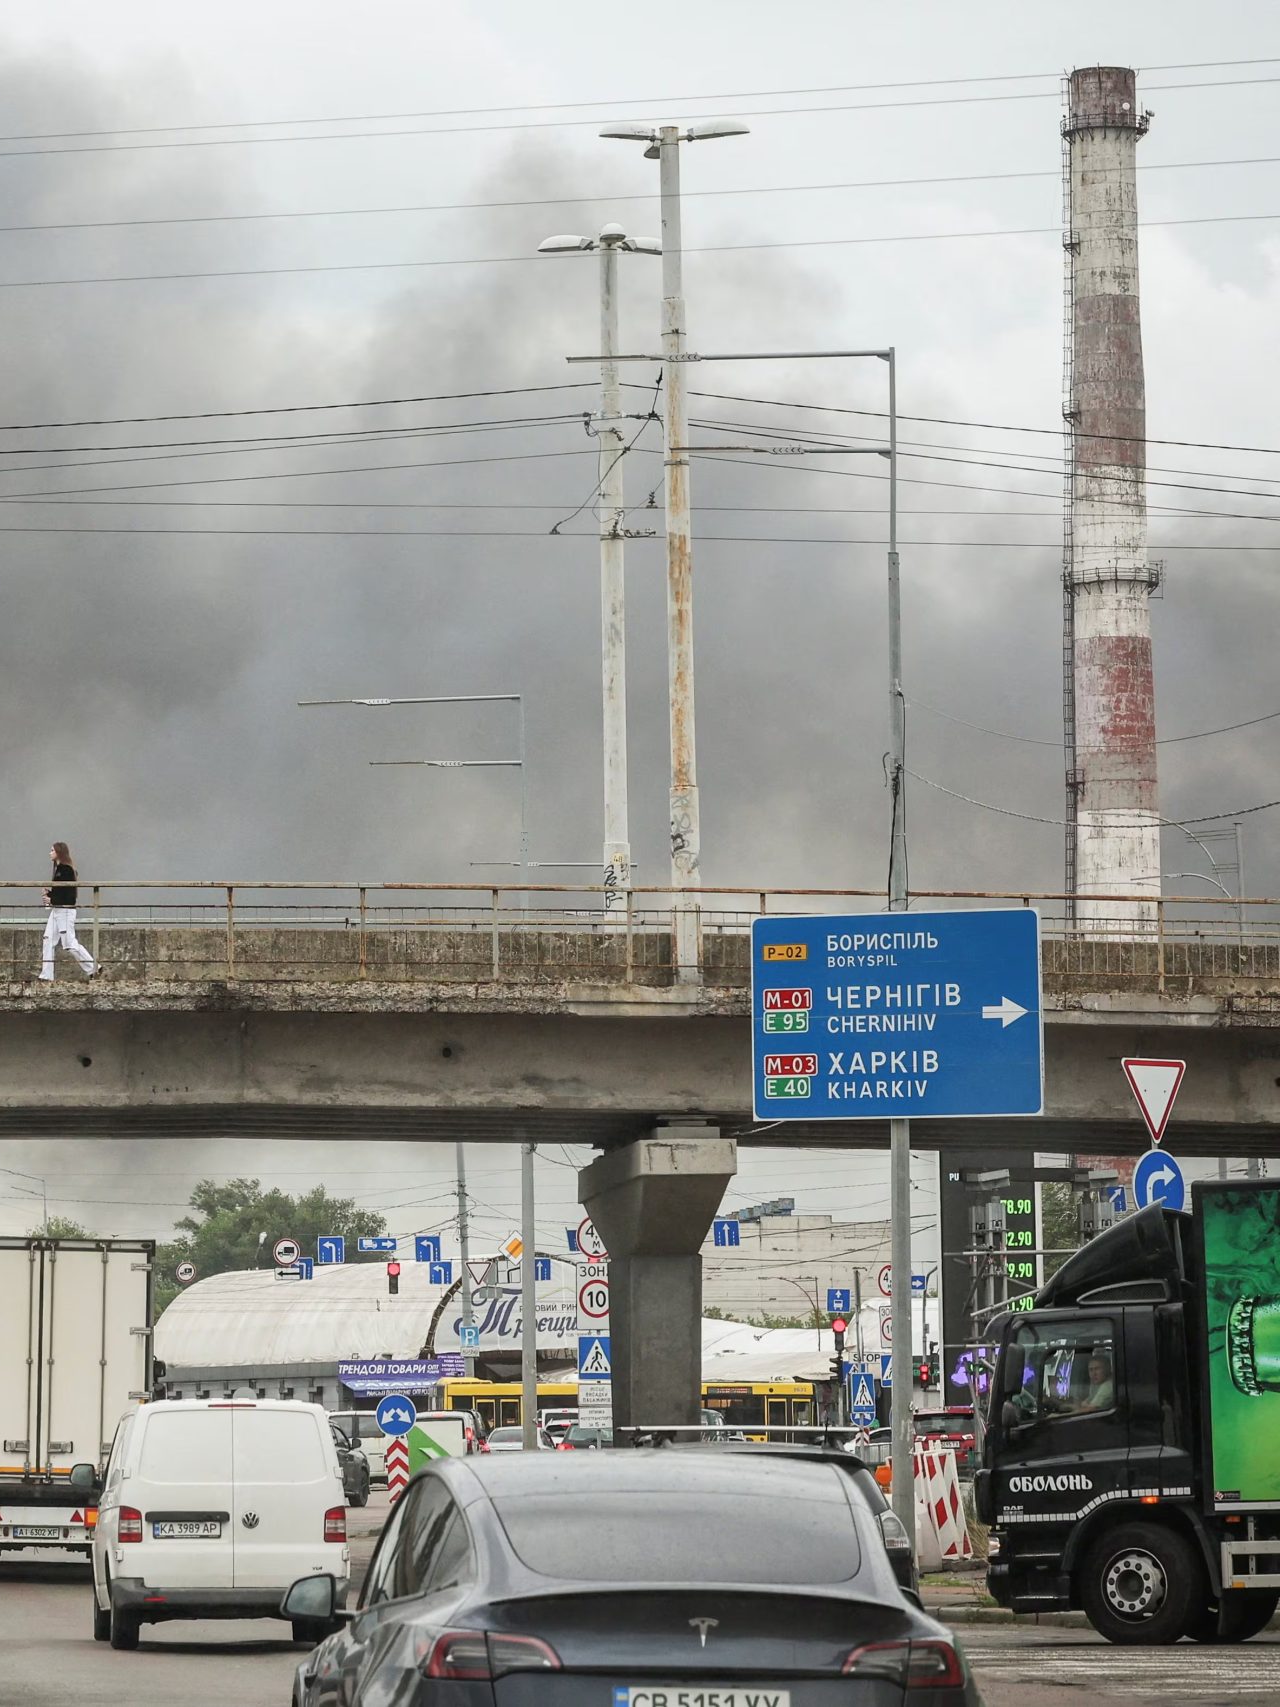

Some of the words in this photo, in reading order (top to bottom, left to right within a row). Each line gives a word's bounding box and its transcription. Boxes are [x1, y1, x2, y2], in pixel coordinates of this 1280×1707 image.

[827, 932, 939, 952] БОРИСПІЛЬ
[827, 955, 898, 968] BORYSPIL
[827, 983, 962, 1009] ЧЕРНІГІВ
[766, 1014, 777, 1031] E
[783, 1013, 806, 1031] 95
[827, 1013, 937, 1034] CHERNIHIV
[828, 1050, 939, 1075] ХАРКІВ
[767, 1080, 778, 1096] E
[784, 1079, 808, 1096] 40
[827, 1079, 928, 1099] KHARKIV
[1005, 1231, 1032, 1247] 2.90
[579, 1265, 609, 1277] ЗОН
[1004, 1263, 1033, 1278] 9.90
[586, 1290, 607, 1308] 10
[1006, 1297, 1034, 1312] 1.90
[853, 1353, 881, 1363] STOP
[338, 1364, 385, 1375] ТРЕНДОВІ
[387, 1364, 427, 1374] ТОВАРИ
[1008, 1474, 1093, 1493] ОБОЛОНЬ
[29, 1527, 46, 1536] 6302
[160, 1524, 175, 1534] KA
[177, 1523, 200, 1534] 3989
[202, 1523, 217, 1534] AP
[677, 1692, 736, 1707] 5151
